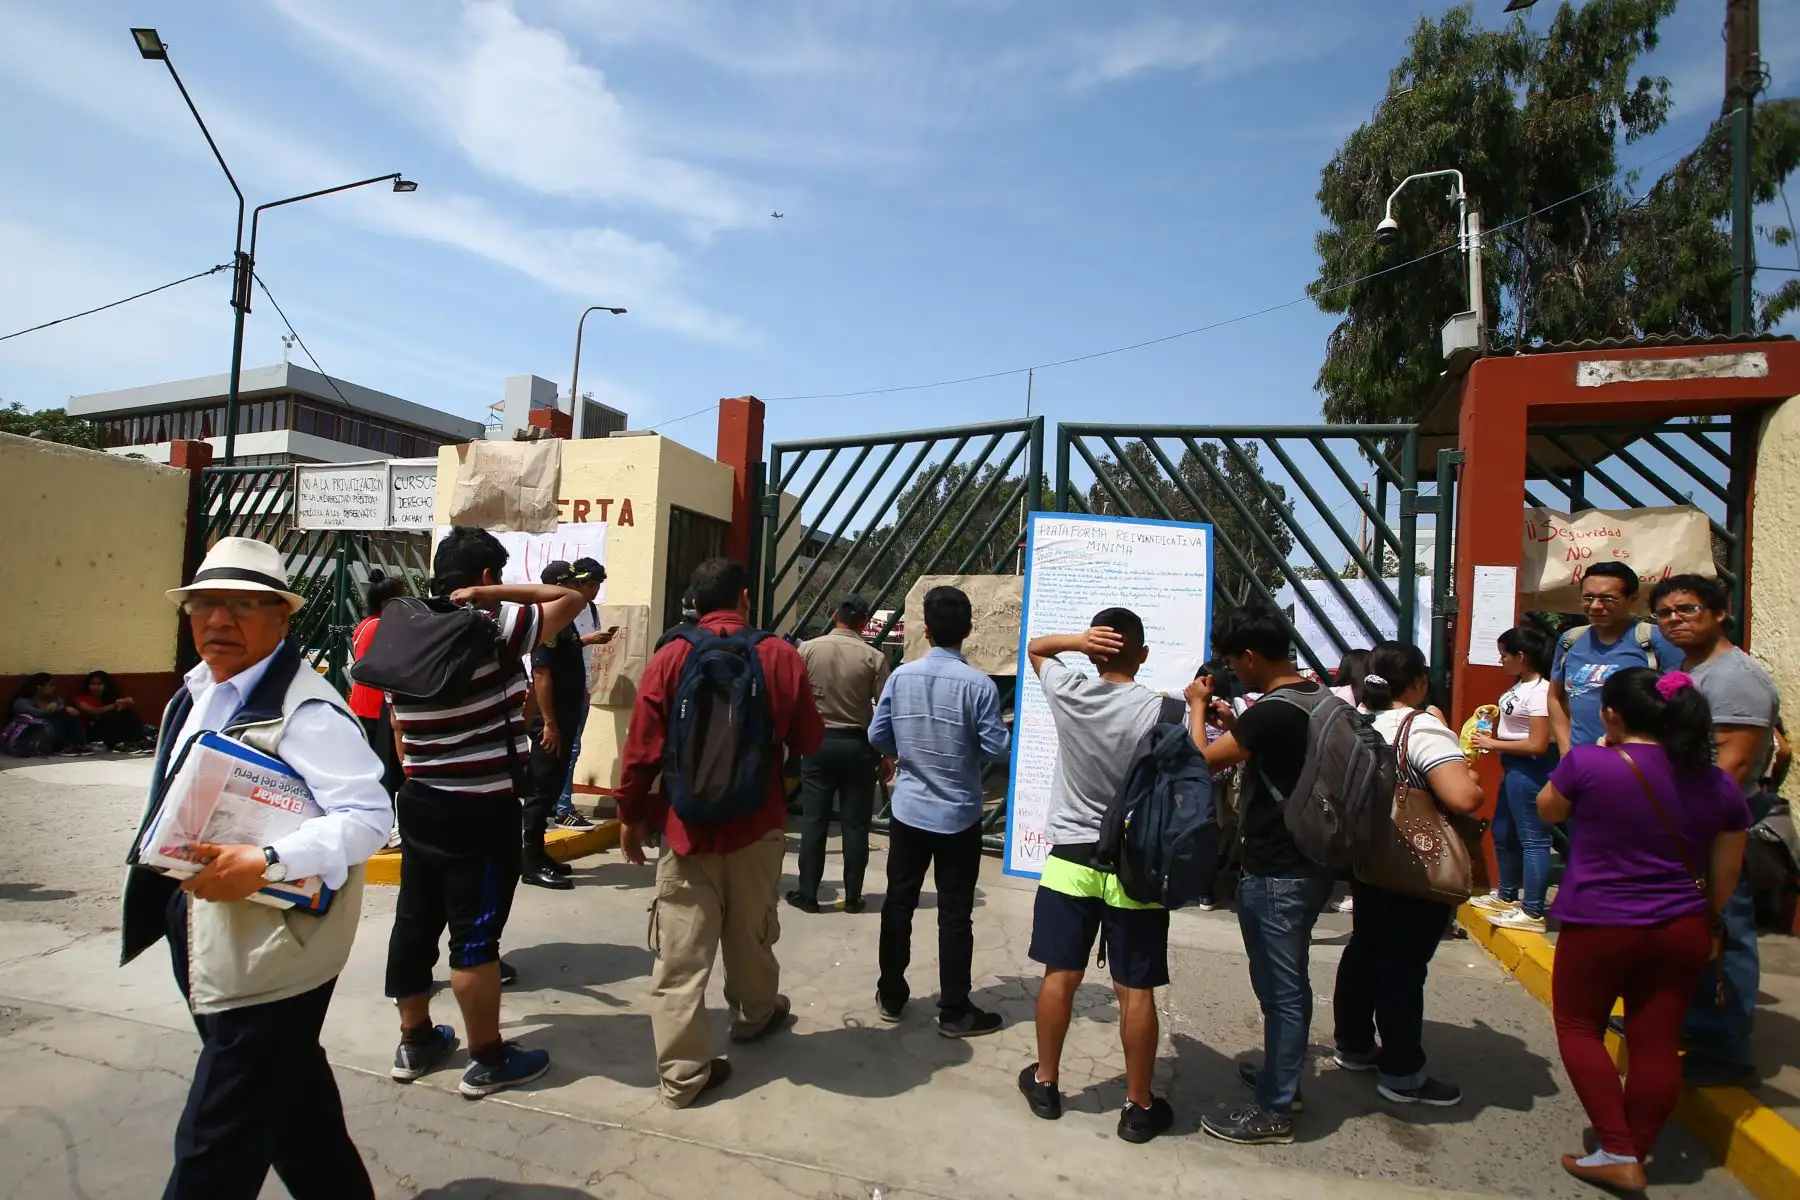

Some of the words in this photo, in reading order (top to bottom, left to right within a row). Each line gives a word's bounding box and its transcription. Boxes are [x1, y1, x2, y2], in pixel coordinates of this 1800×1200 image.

[302, 478, 310, 491] NO
[320, 478, 329, 492] LA
[332, 474, 384, 492] PRIVATIZACIÓN
[393, 475, 437, 490] CURSOS
[309, 493, 316, 501] LA
[398, 496, 433, 509] DERECHO
[557, 498, 635, 527] ERTA
[1566, 546, 1593, 561] NO
[1612, 549, 1631, 558] es
[234, 767, 260, 783] Perú
[260, 776, 277, 788] del
[253, 788, 291, 812] Dakar
[289, 799, 304, 814] El
